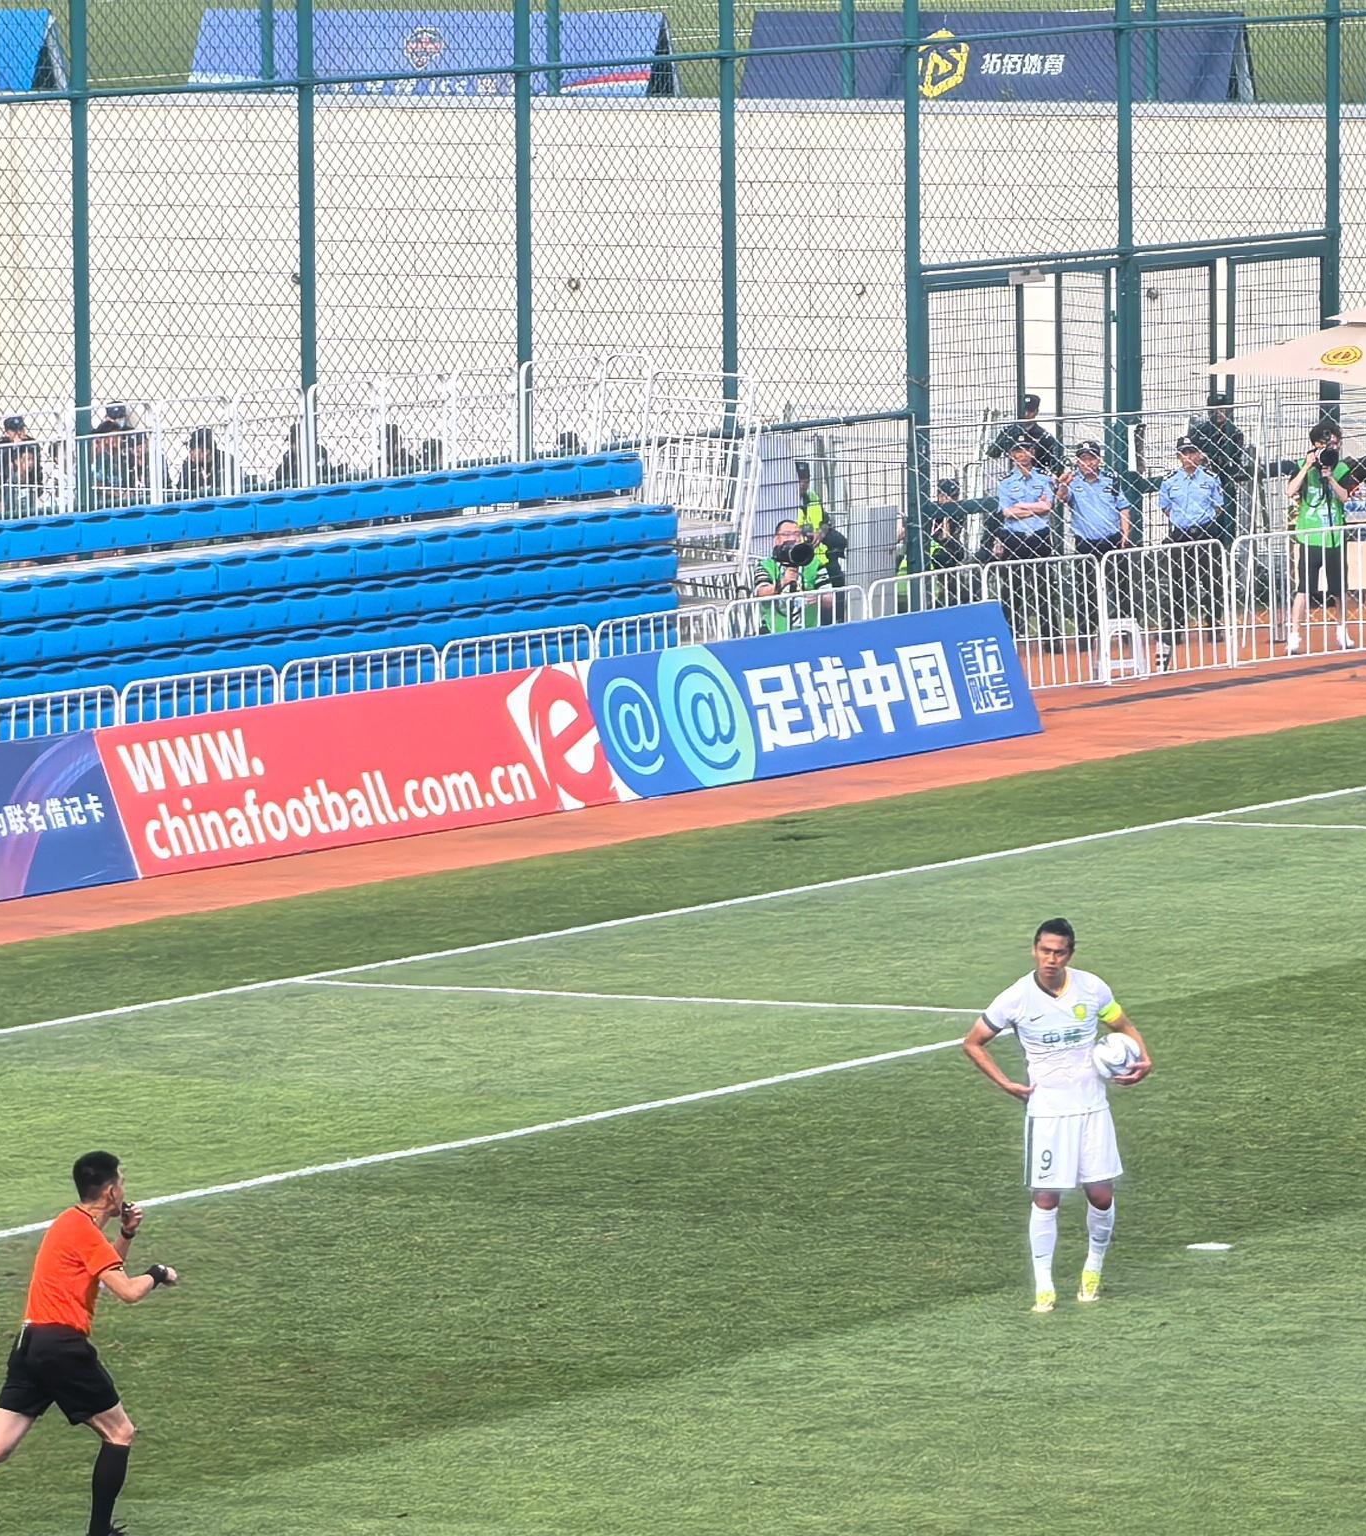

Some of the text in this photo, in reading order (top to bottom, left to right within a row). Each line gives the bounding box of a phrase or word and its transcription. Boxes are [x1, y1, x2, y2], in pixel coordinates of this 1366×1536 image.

[743, 641, 962, 752] 足球中国
[145, 762, 537, 860] chinafootball.com.cn
[1040, 1149, 1052, 1171] 9
